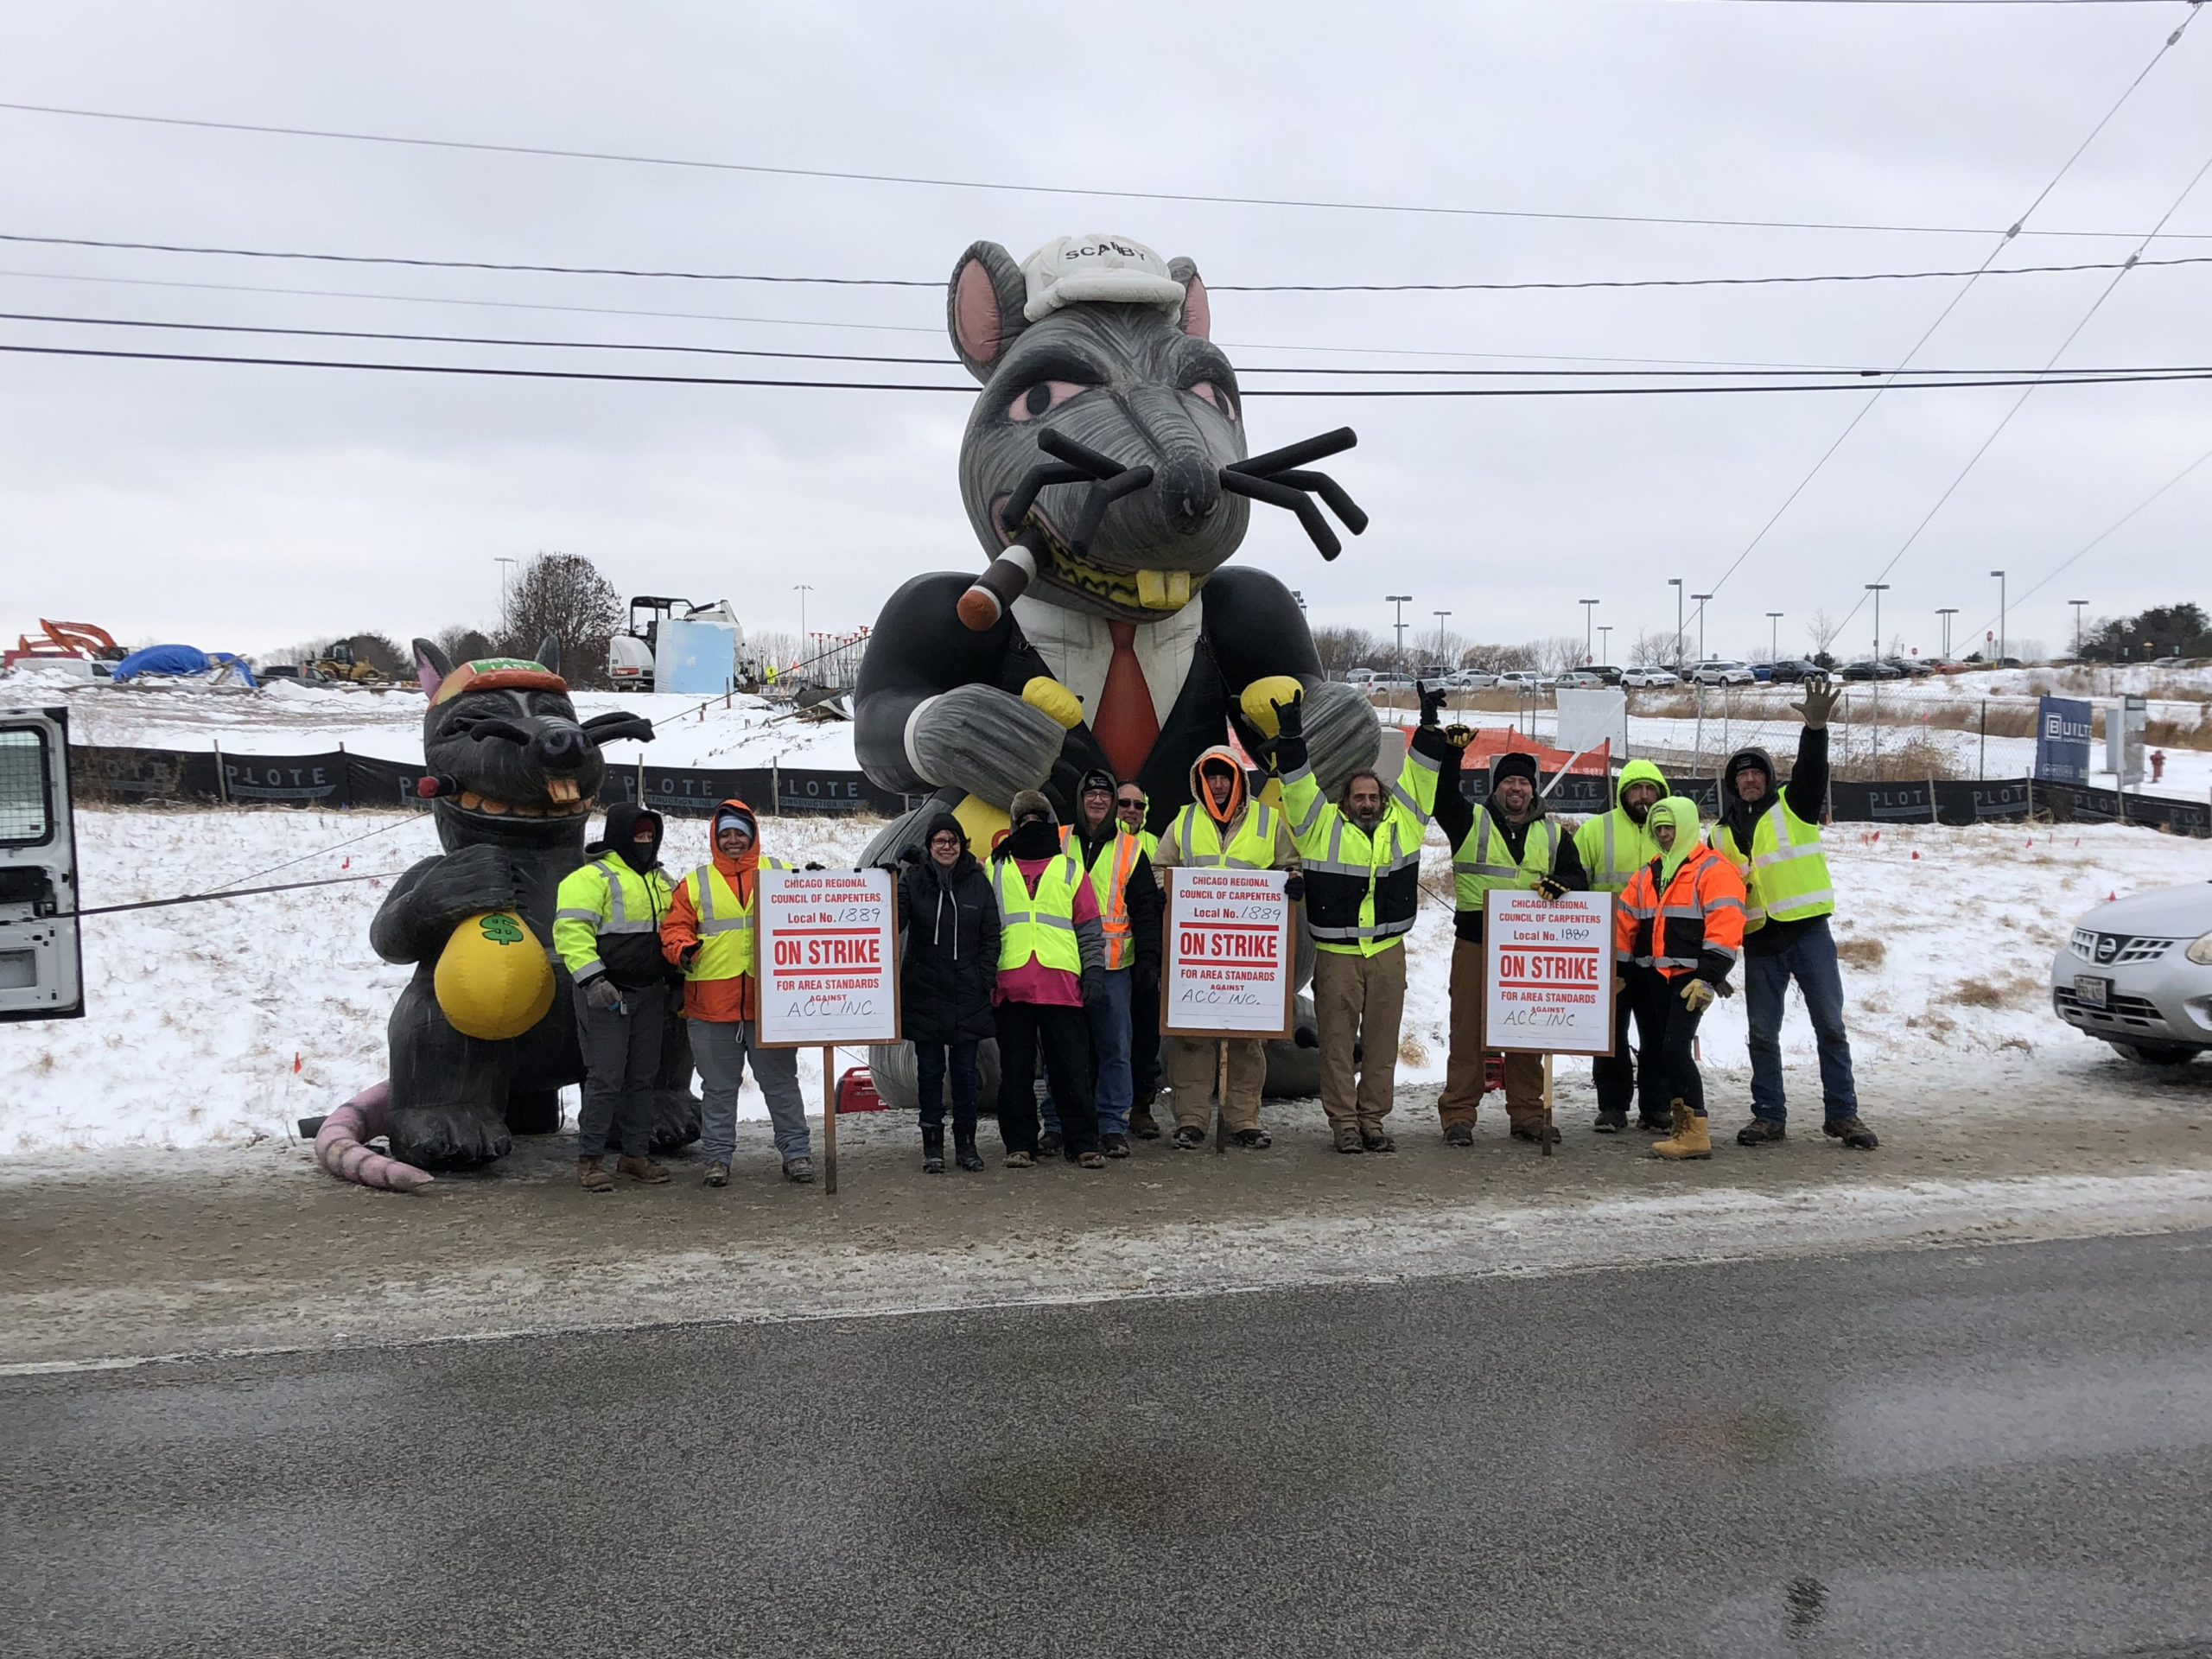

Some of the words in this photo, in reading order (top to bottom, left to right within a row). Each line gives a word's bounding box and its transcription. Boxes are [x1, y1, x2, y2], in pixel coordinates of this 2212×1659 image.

[224, 765, 327, 787] PLOTE
[1556, 782, 1599, 798] OTE
[1870, 789, 1923, 807] PLOT
[785, 878, 823, 888] CHICAGO
[825, 878, 868, 888] REGIONAL
[1192, 876, 1228, 886] CHICAGO
[1230, 877, 1269, 887] REGIONAL
[771, 893, 809, 904] COUNCIL
[810, 893, 822, 903] OF
[825, 893, 881, 903] CARPENTERS
[1179, 889, 1214, 899] COUNCIL
[1216, 891, 1227, 899] OF
[1229, 891, 1281, 902] CARPENTERS
[1511, 899, 1548, 909] CHICAGO
[1549, 900, 1589, 909] REGIONAL
[787, 912, 816, 924] Local
[819, 912, 836, 923] No.
[838, 907, 881, 923] 1889
[1193, 906, 1220, 918] Local
[1223, 908, 1239, 918] No.
[1241, 906, 1281, 922] 1889
[1499, 912, 1533, 922] COUNCIL
[1535, 913, 1547, 922] OF
[1548, 914, 1601, 924] CARPENTERS
[1513, 930, 1540, 940] Local
[1542, 931, 1559, 941] No.
[1561, 928, 1590, 940] 1889
[774, 940, 802, 965] ON
[808, 938, 880, 965] STRIKE
[1180, 931, 1205, 956] ON
[1211, 932, 1277, 958] STRIKE
[1180, 969, 1198, 979] FOR
[1199, 969, 1223, 980] AREA
[1224, 970, 1275, 982] STANDARDS
[1500, 955, 1525, 977] ON
[1531, 956, 1598, 980] STRIKE
[776, 980, 796, 991] FOR
[798, 980, 823, 990] AREA
[825, 978, 880, 990] STANDARDS
[1181, 988, 1221, 1004] ACC
[1229, 993, 1261, 1006] INC.
[1501, 991, 1518, 1001] FOR
[1520, 992, 1543, 1002] AREA
[1545, 993, 1596, 1003] STANDARDS
[786, 1000, 831, 1018] ACC
[1503, 1009, 1537, 1026] ACC
